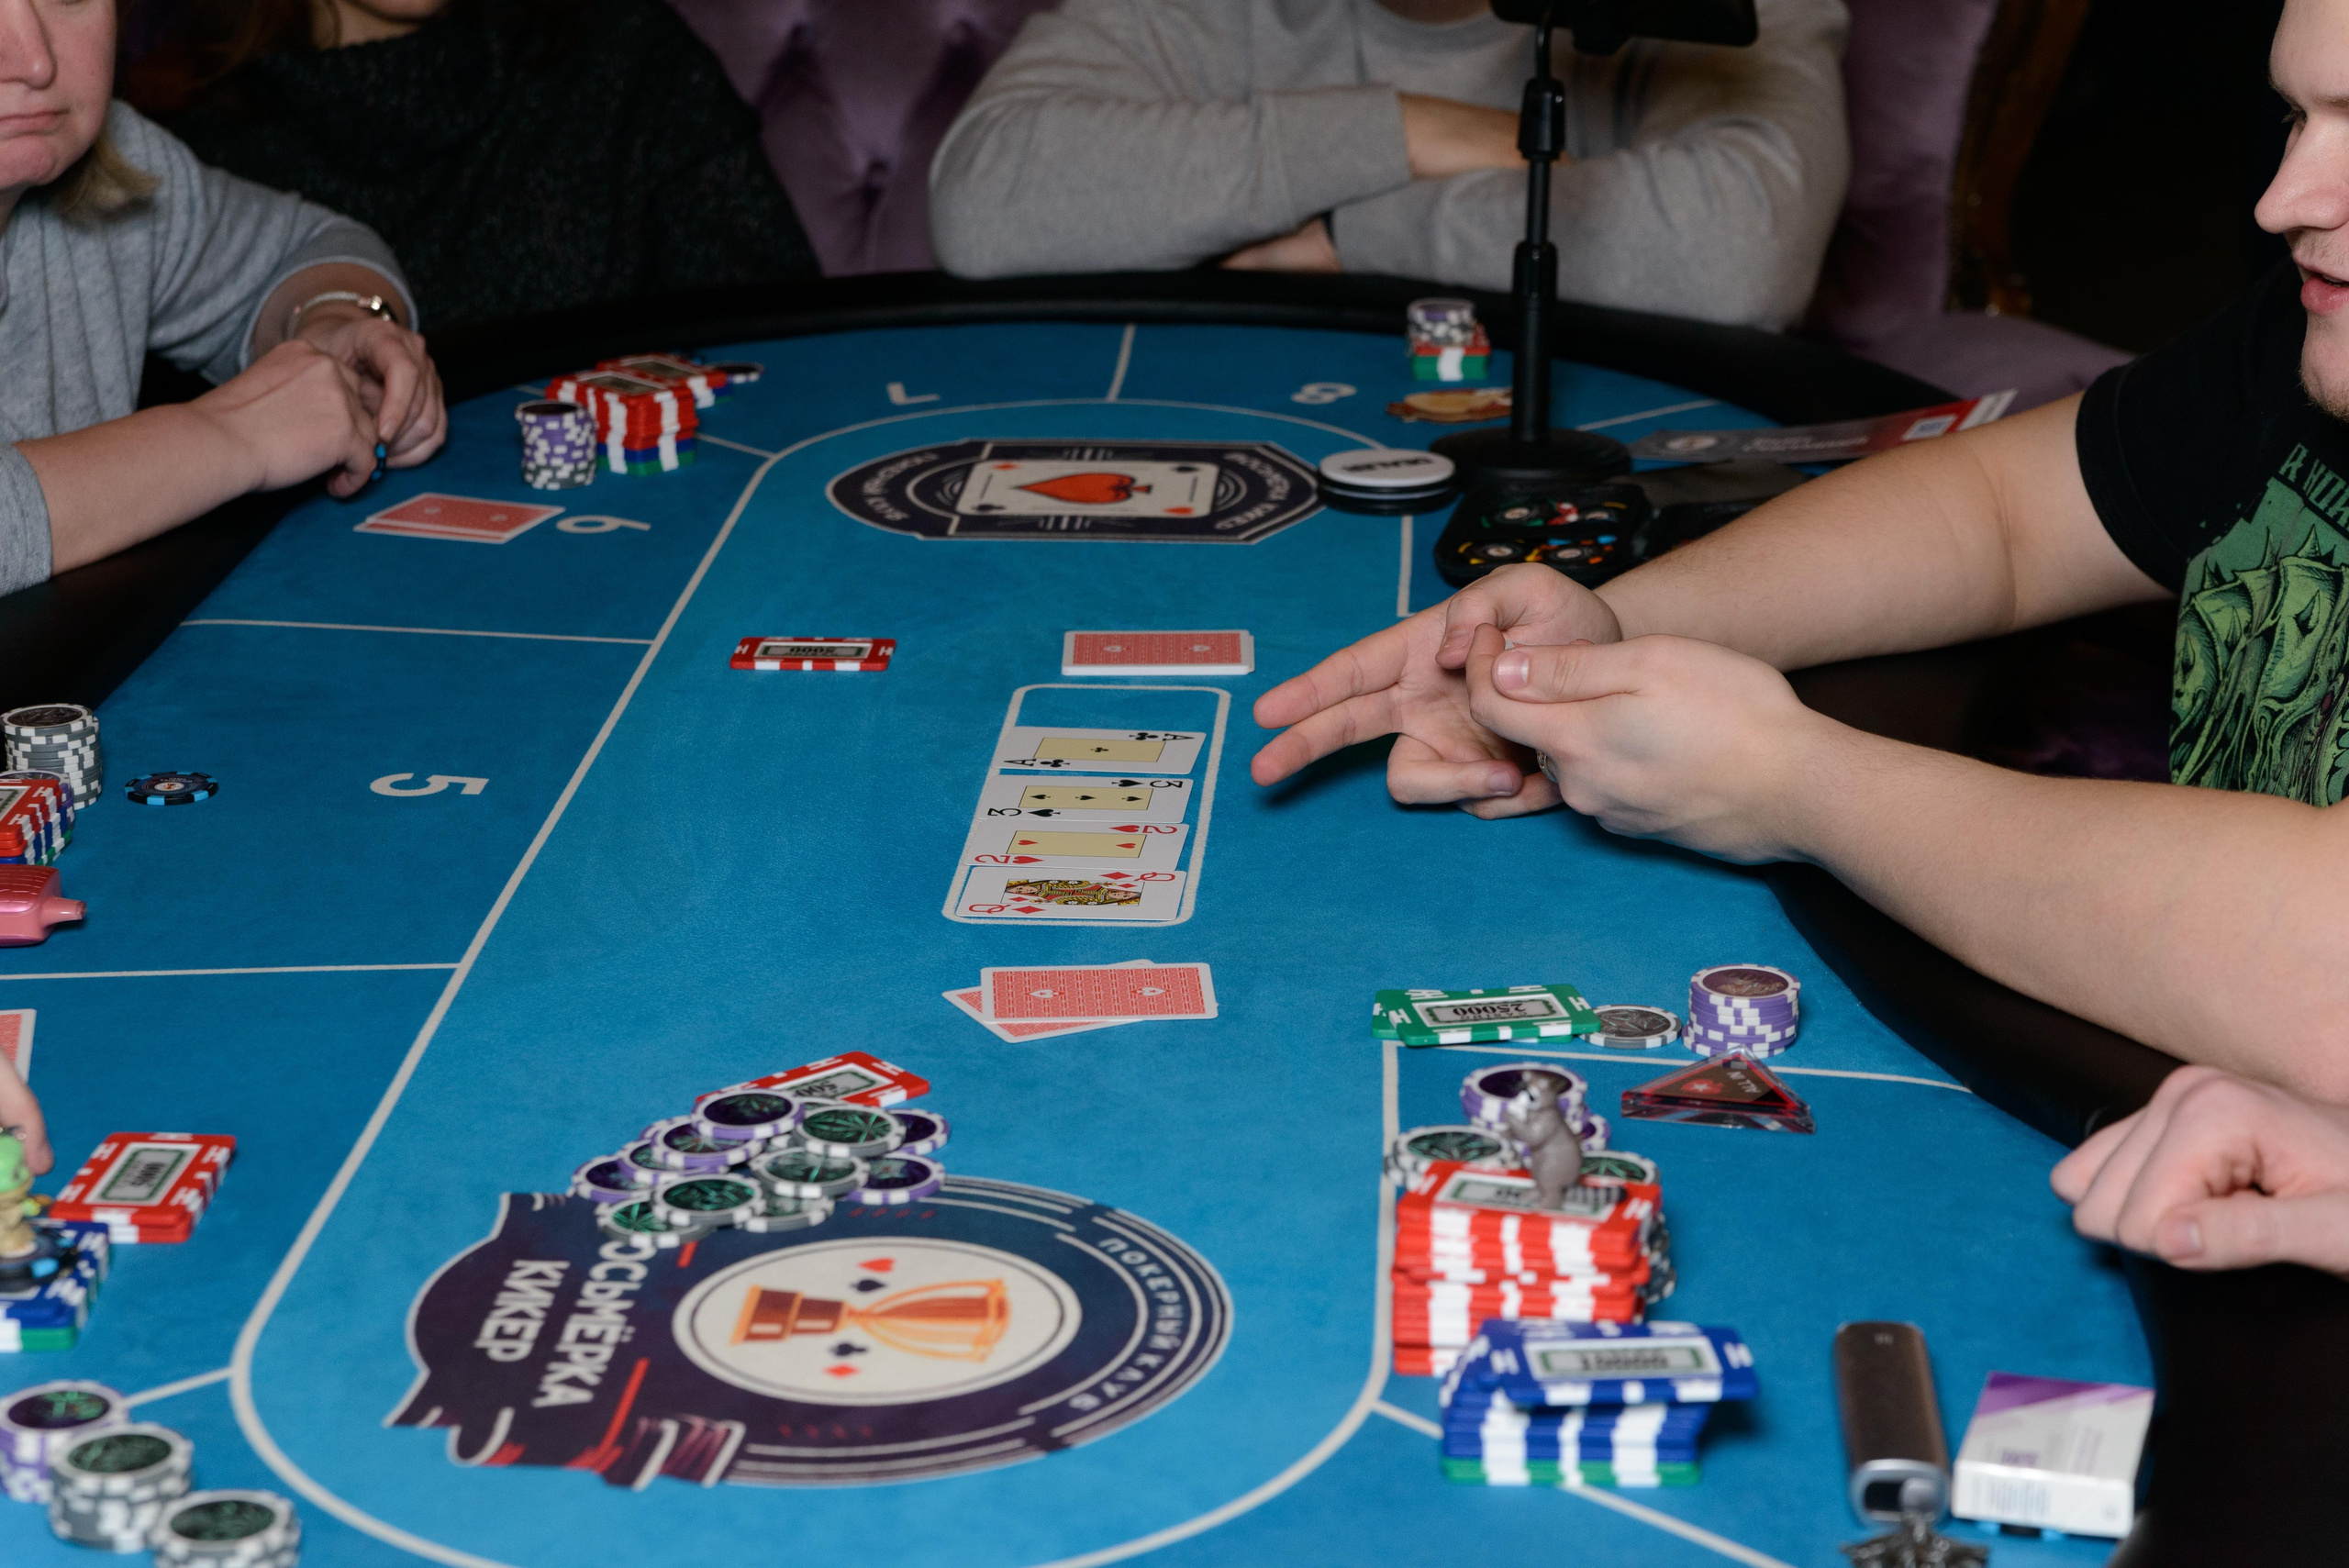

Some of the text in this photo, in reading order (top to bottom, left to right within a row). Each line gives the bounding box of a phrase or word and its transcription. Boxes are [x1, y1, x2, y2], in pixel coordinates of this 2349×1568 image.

[886, 382, 940, 405] 7
[1290, 383, 1357, 404] 8
[556, 515, 651, 534] 6
[1163, 733, 1195, 743] A
[1004, 758, 1036, 768] A
[370, 773, 490, 796] 5
[1150, 779, 1184, 790] 3
[987, 806, 1022, 817] 3
[1142, 825, 1178, 835] 2
[974, 854, 1011, 864] 2
[1134, 872, 1176, 883] Q
[969, 903, 1011, 914] Q
[1453, 1003, 1527, 1017] 25000
[1727, 1072, 1761, 1093] ALL IN
[1099, 1238, 1184, 1350] ПОКЕРНЫЙ
[473, 1259, 571, 1362] КИКЕР
[530, 1240, 657, 1408] ОСЬМЁРКА
